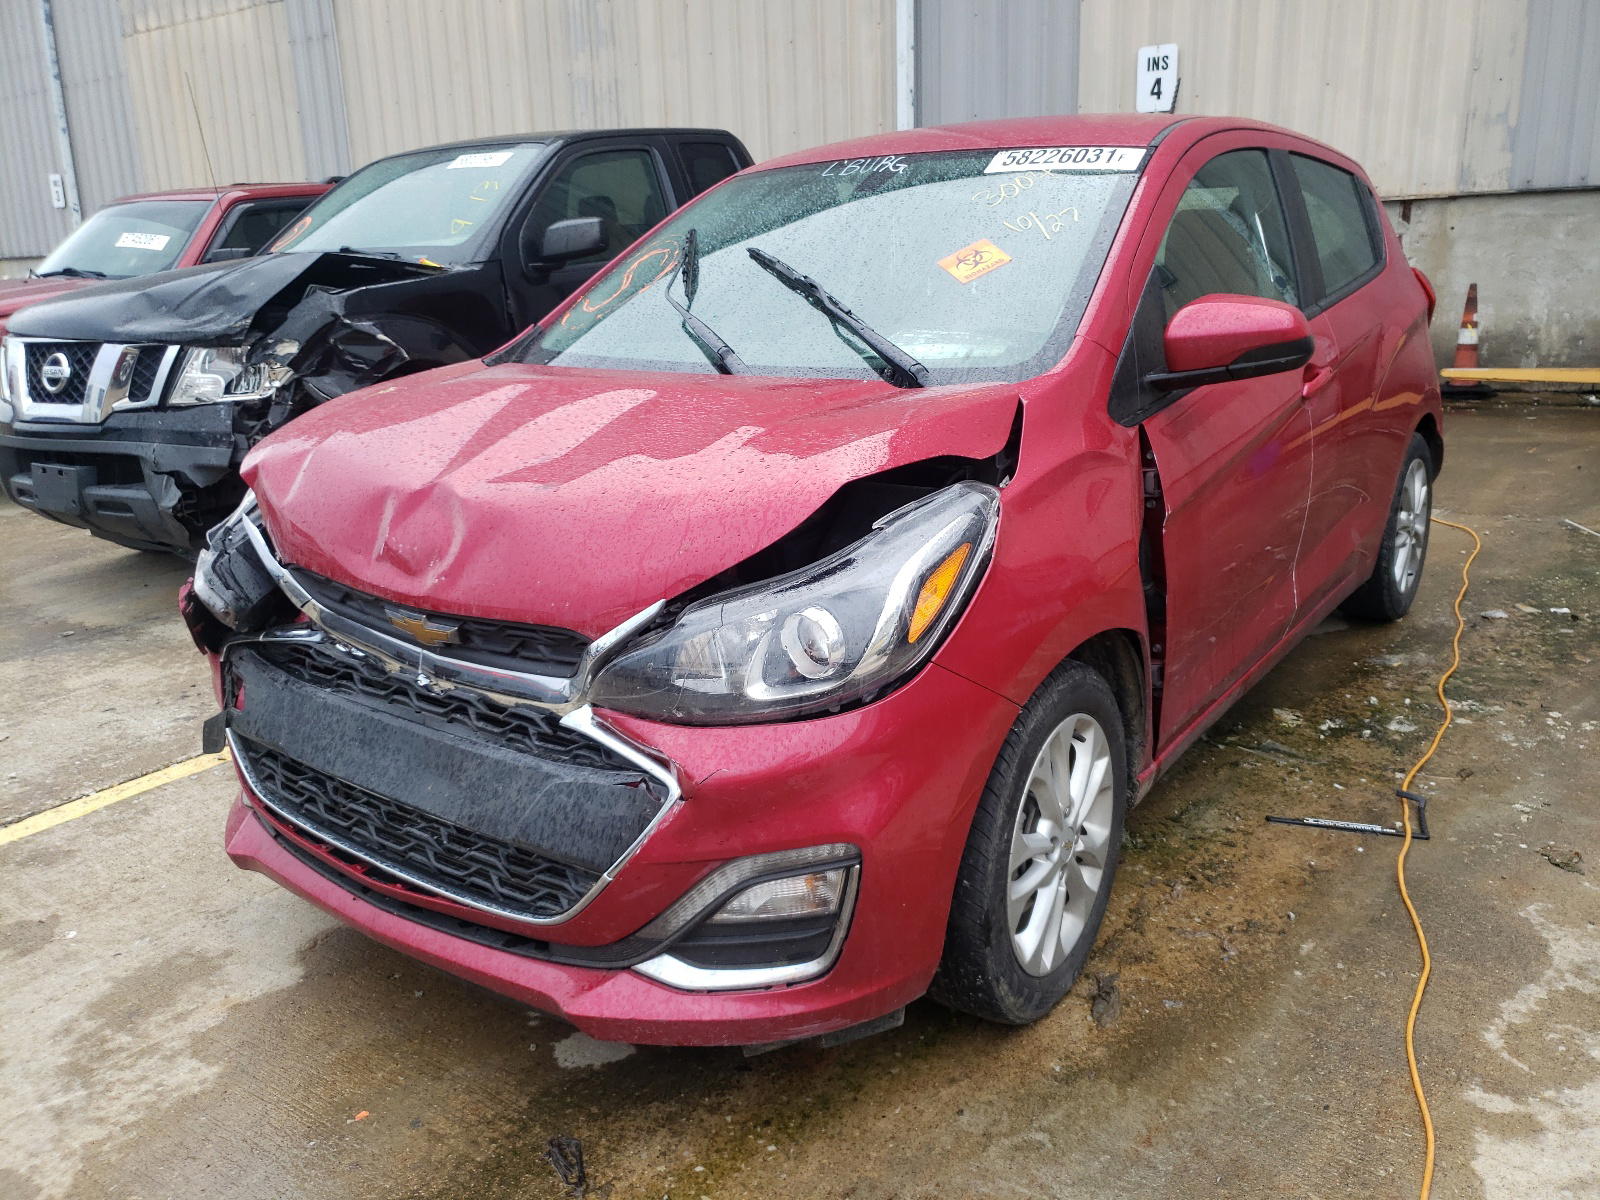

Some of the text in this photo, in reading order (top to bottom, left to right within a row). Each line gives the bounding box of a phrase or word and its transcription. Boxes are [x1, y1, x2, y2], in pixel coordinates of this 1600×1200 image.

[1147, 55, 1169, 72] INS
[1150, 77, 1162, 100] 4
[1002, 148, 1117, 166] 58226031
[1003, 207, 1079, 240] 10/27
